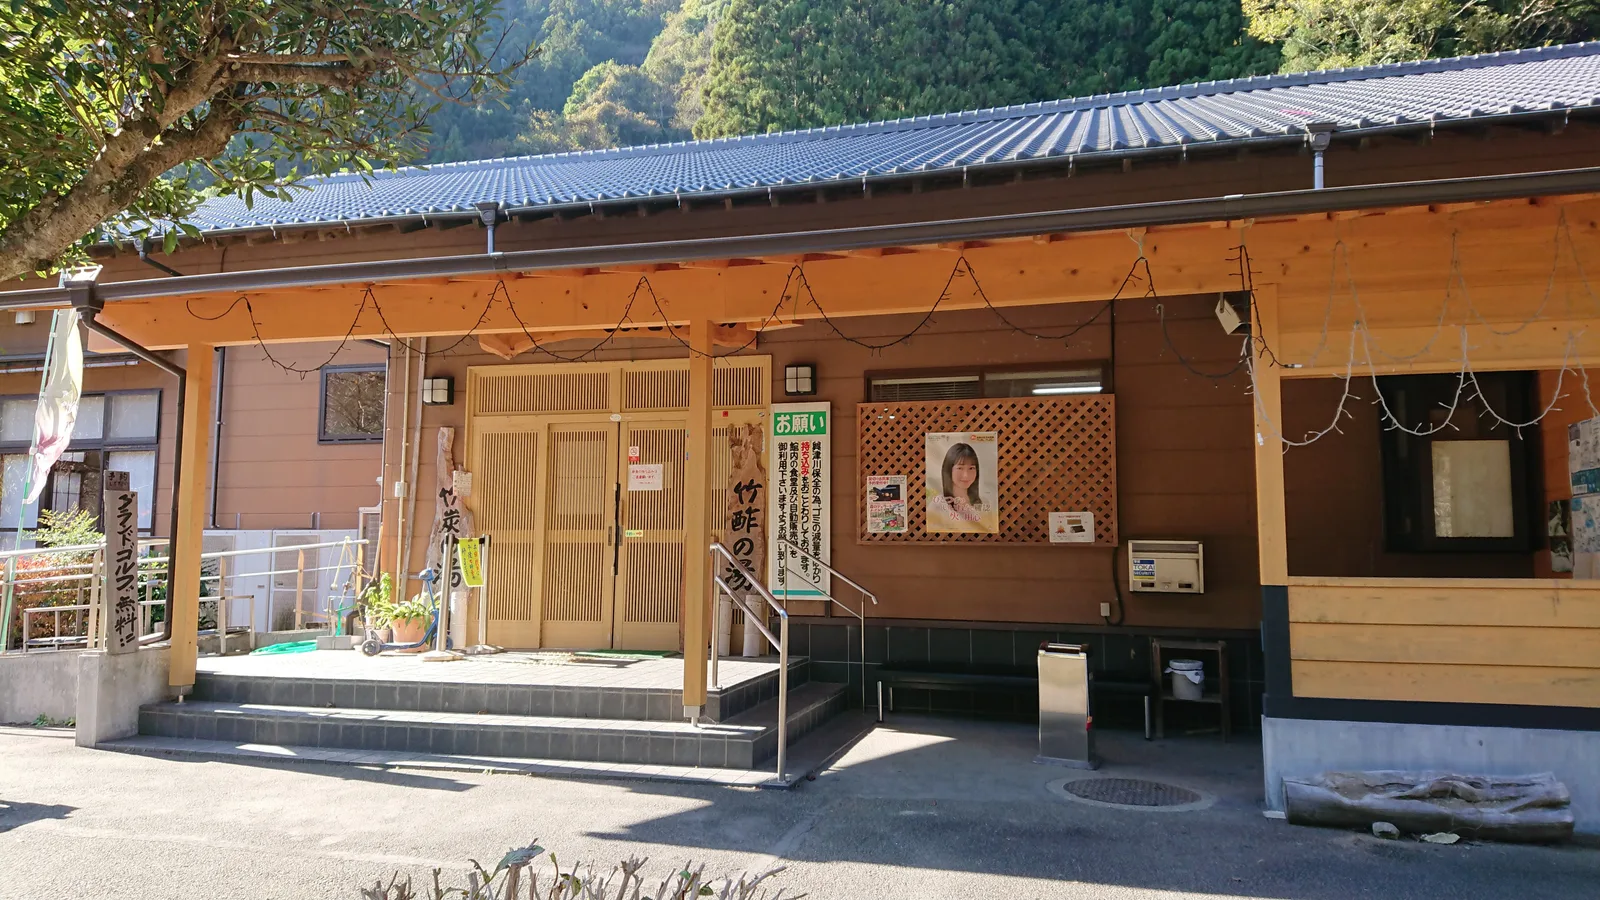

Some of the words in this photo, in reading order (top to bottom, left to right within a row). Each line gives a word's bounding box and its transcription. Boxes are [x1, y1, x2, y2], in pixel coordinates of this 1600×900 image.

[776, 413, 825, 433] お願い
[725, 479, 763, 592] 竹酢の湯
